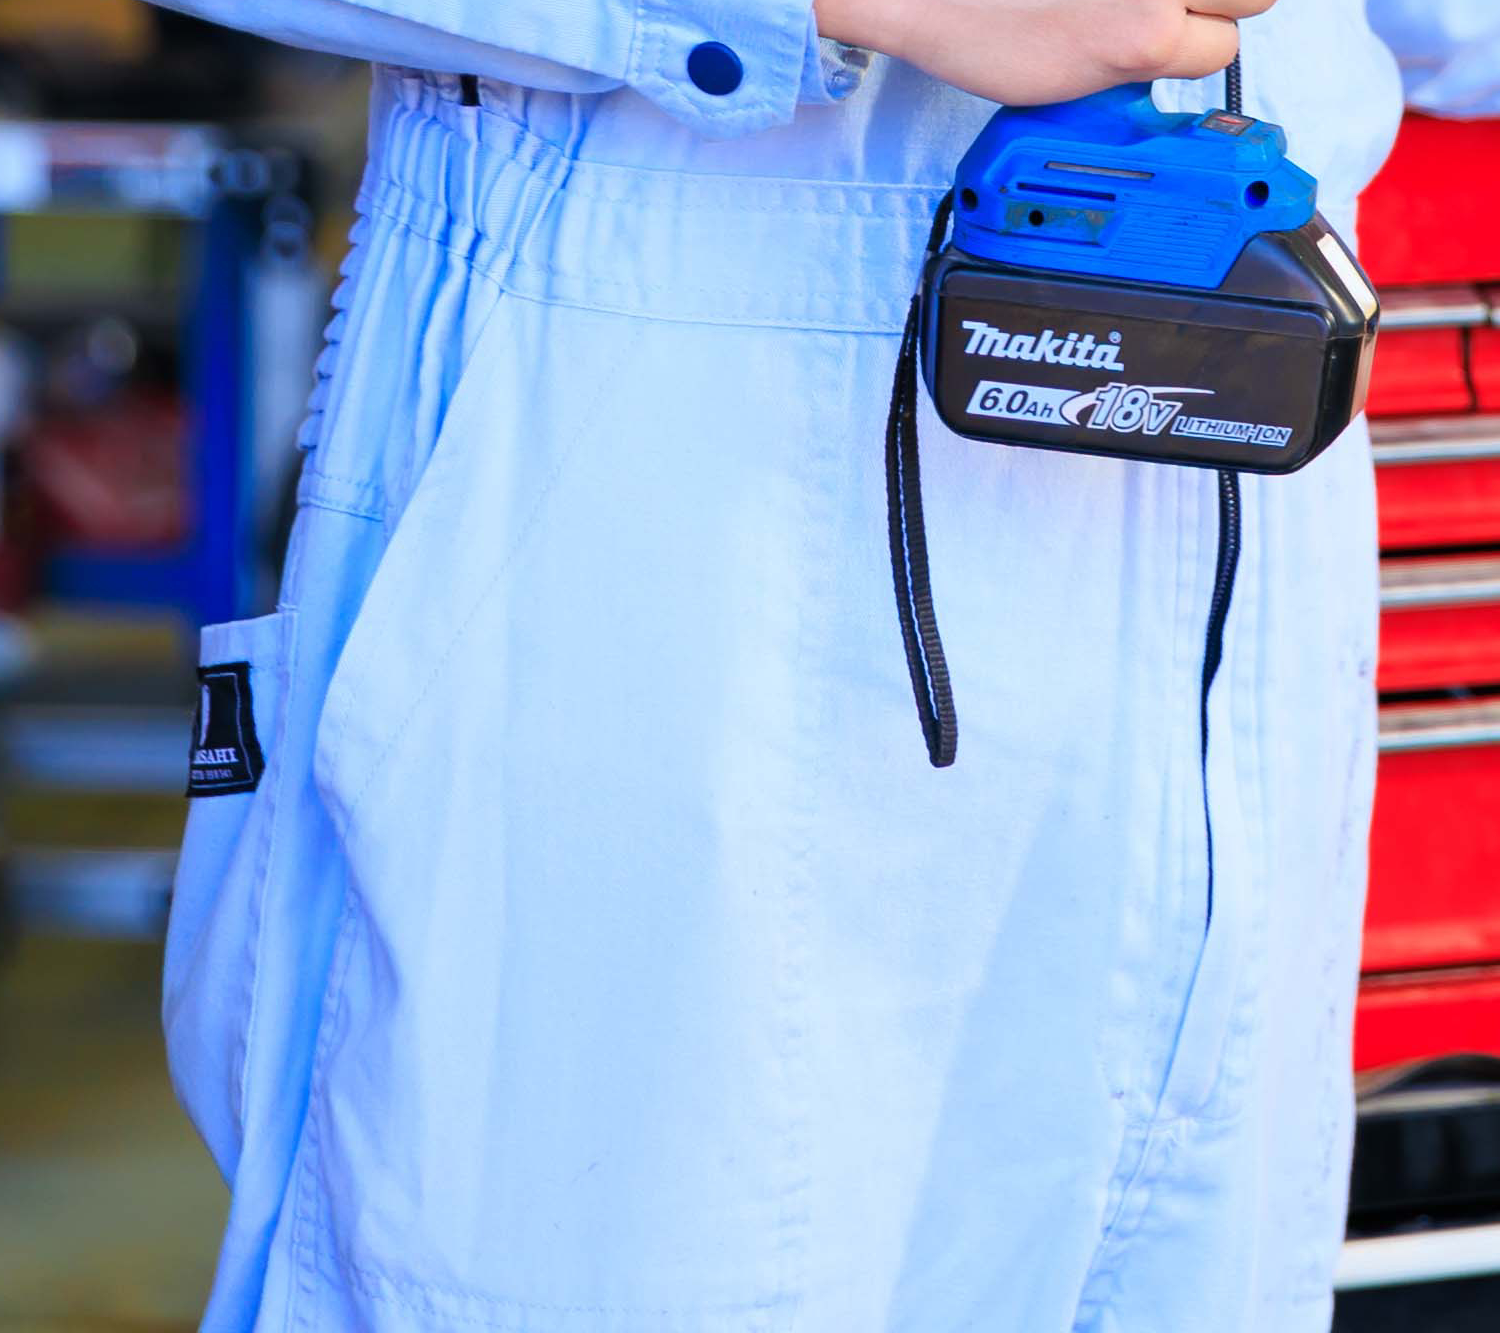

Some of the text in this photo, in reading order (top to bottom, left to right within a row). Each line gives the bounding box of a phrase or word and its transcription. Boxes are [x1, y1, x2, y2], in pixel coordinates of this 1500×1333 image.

[979, 382, 1293, 447] 6.0Ah 18V LITHIUM-ION
